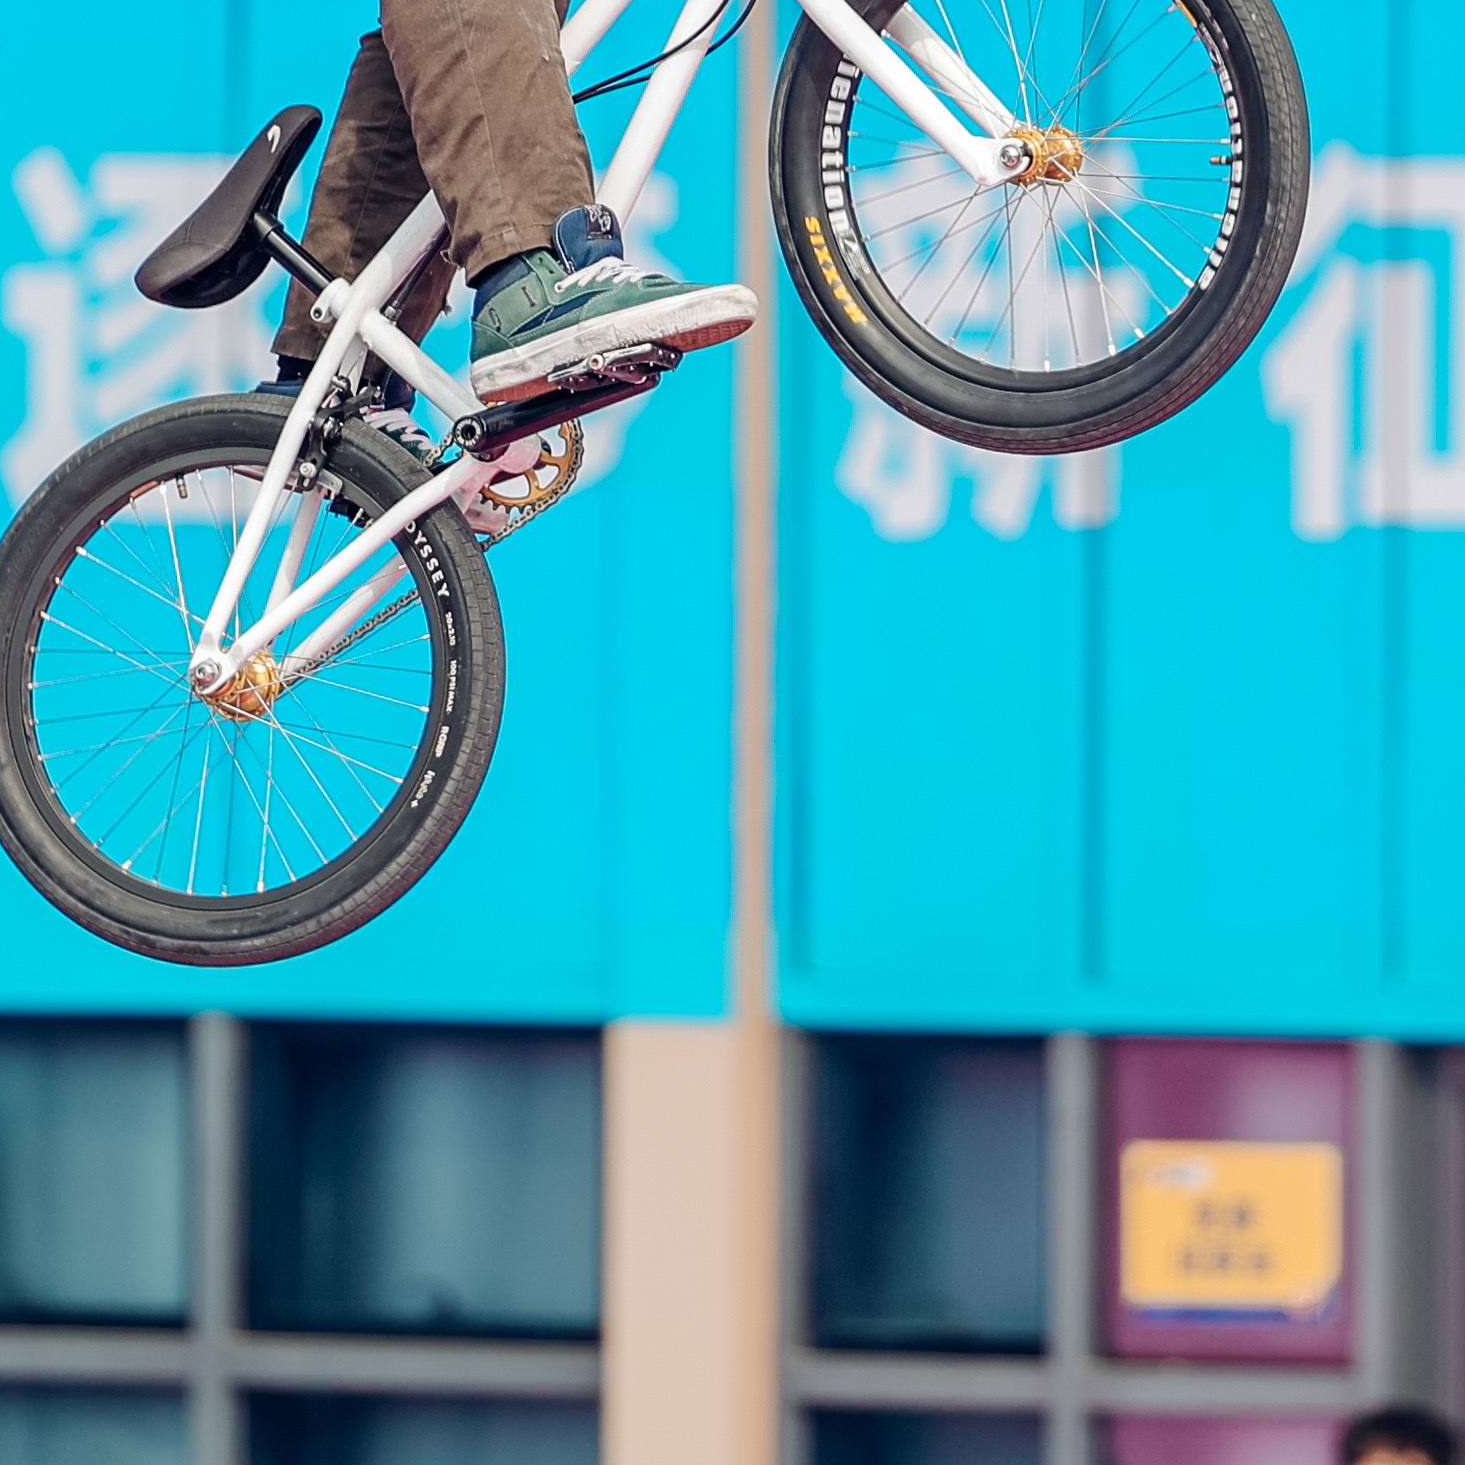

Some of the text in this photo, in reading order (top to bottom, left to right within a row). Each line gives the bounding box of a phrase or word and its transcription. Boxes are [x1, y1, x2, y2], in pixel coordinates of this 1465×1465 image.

[821, 53, 860, 233] ienation
[804, 215, 869, 325] MAXXIS
[405, 520, 450, 597] DYSSEY
[449, 659, 457, 676] 100
